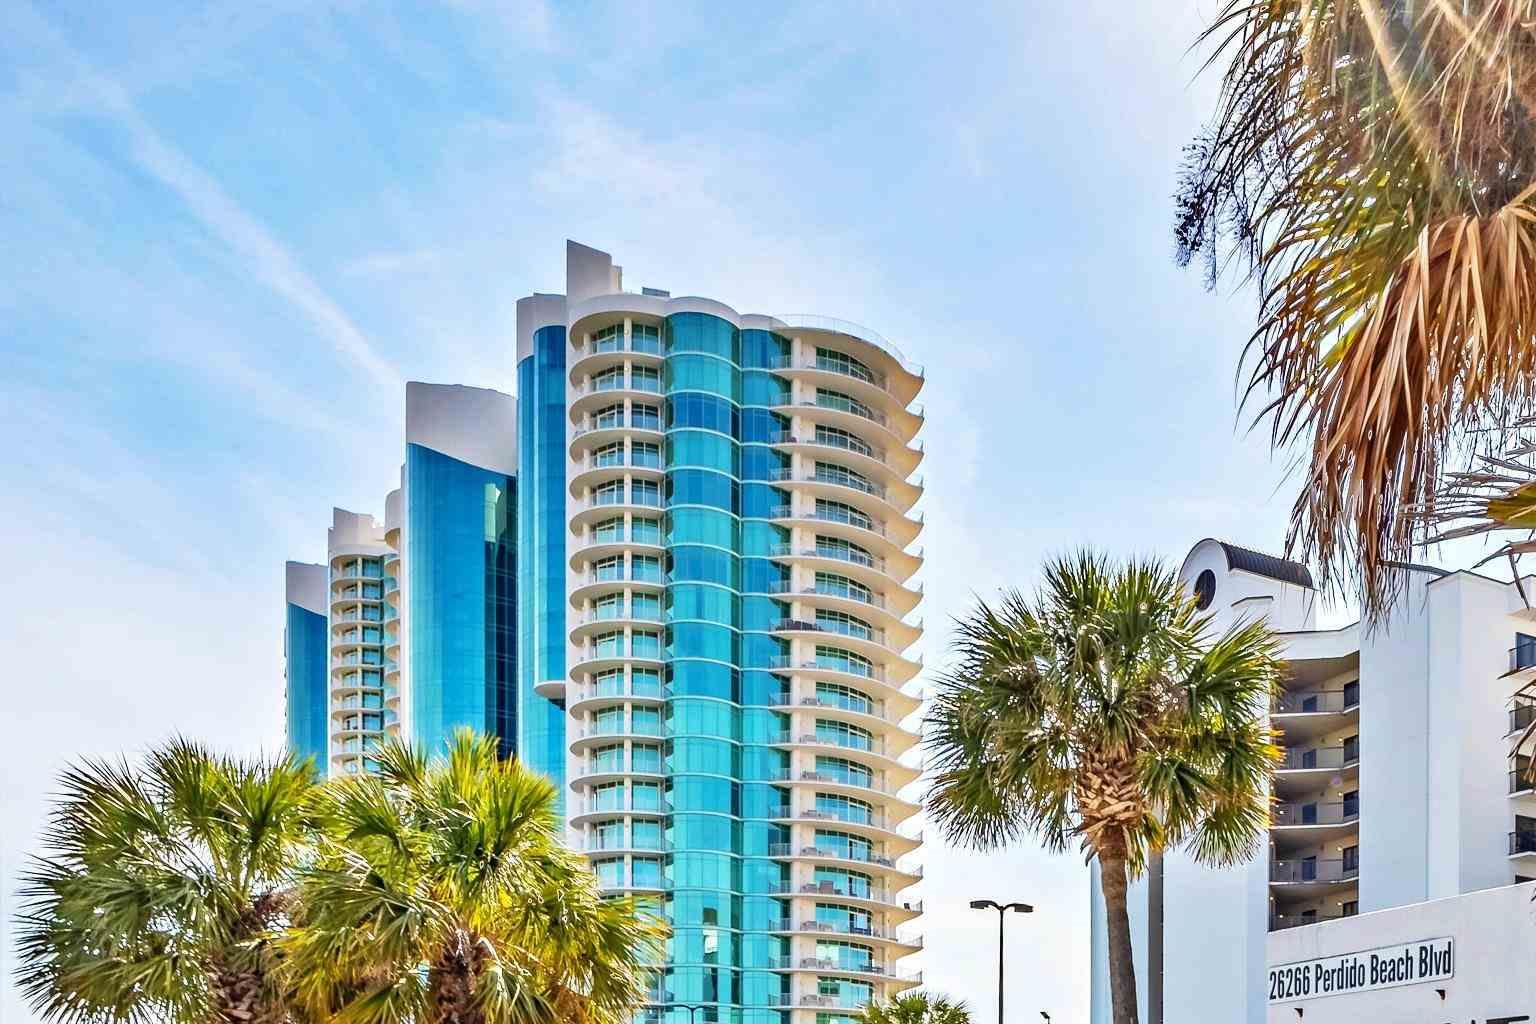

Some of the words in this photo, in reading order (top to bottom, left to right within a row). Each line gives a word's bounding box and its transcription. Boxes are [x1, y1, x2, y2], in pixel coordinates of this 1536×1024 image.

[1269, 965, 1310, 1000] 26266
[1315, 959, 1365, 994] Perdido
[1370, 949, 1413, 985] Beach
[1418, 941, 1451, 978] Blvd
